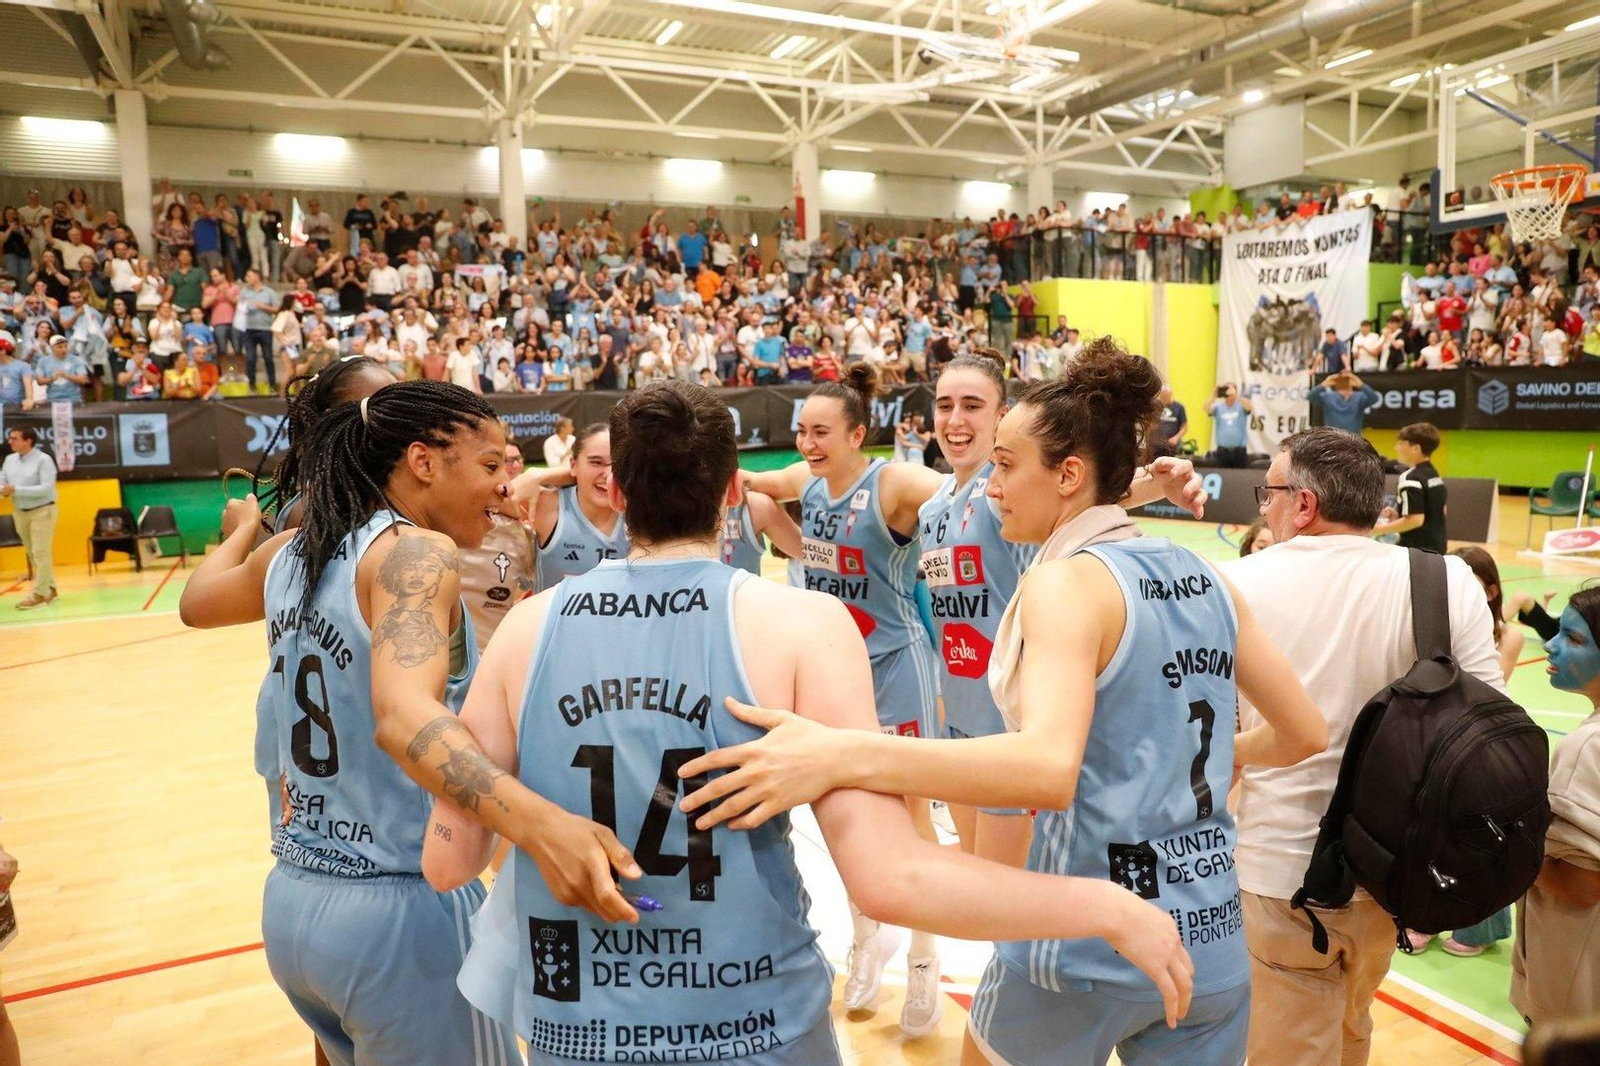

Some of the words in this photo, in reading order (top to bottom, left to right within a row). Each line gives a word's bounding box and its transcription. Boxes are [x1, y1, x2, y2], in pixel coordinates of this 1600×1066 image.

[1284, 267, 1292, 284] O
[1295, 262, 1327, 282] FINAL
[1515, 382, 1571, 396] SAVINO
[813, 510, 842, 540] 55
[936, 511, 950, 544] 6
[558, 676, 712, 731] GARFELLA
[570, 745, 722, 902] 14
[1157, 826, 1226, 861] XUNTA
[1166, 862, 1194, 884] DE
[590, 928, 702, 955] XUNTA
[592, 962, 632, 988] DE
[639, 954, 775, 989] GALICIA
[615, 1008, 776, 1047] DEPUTACIÓN
